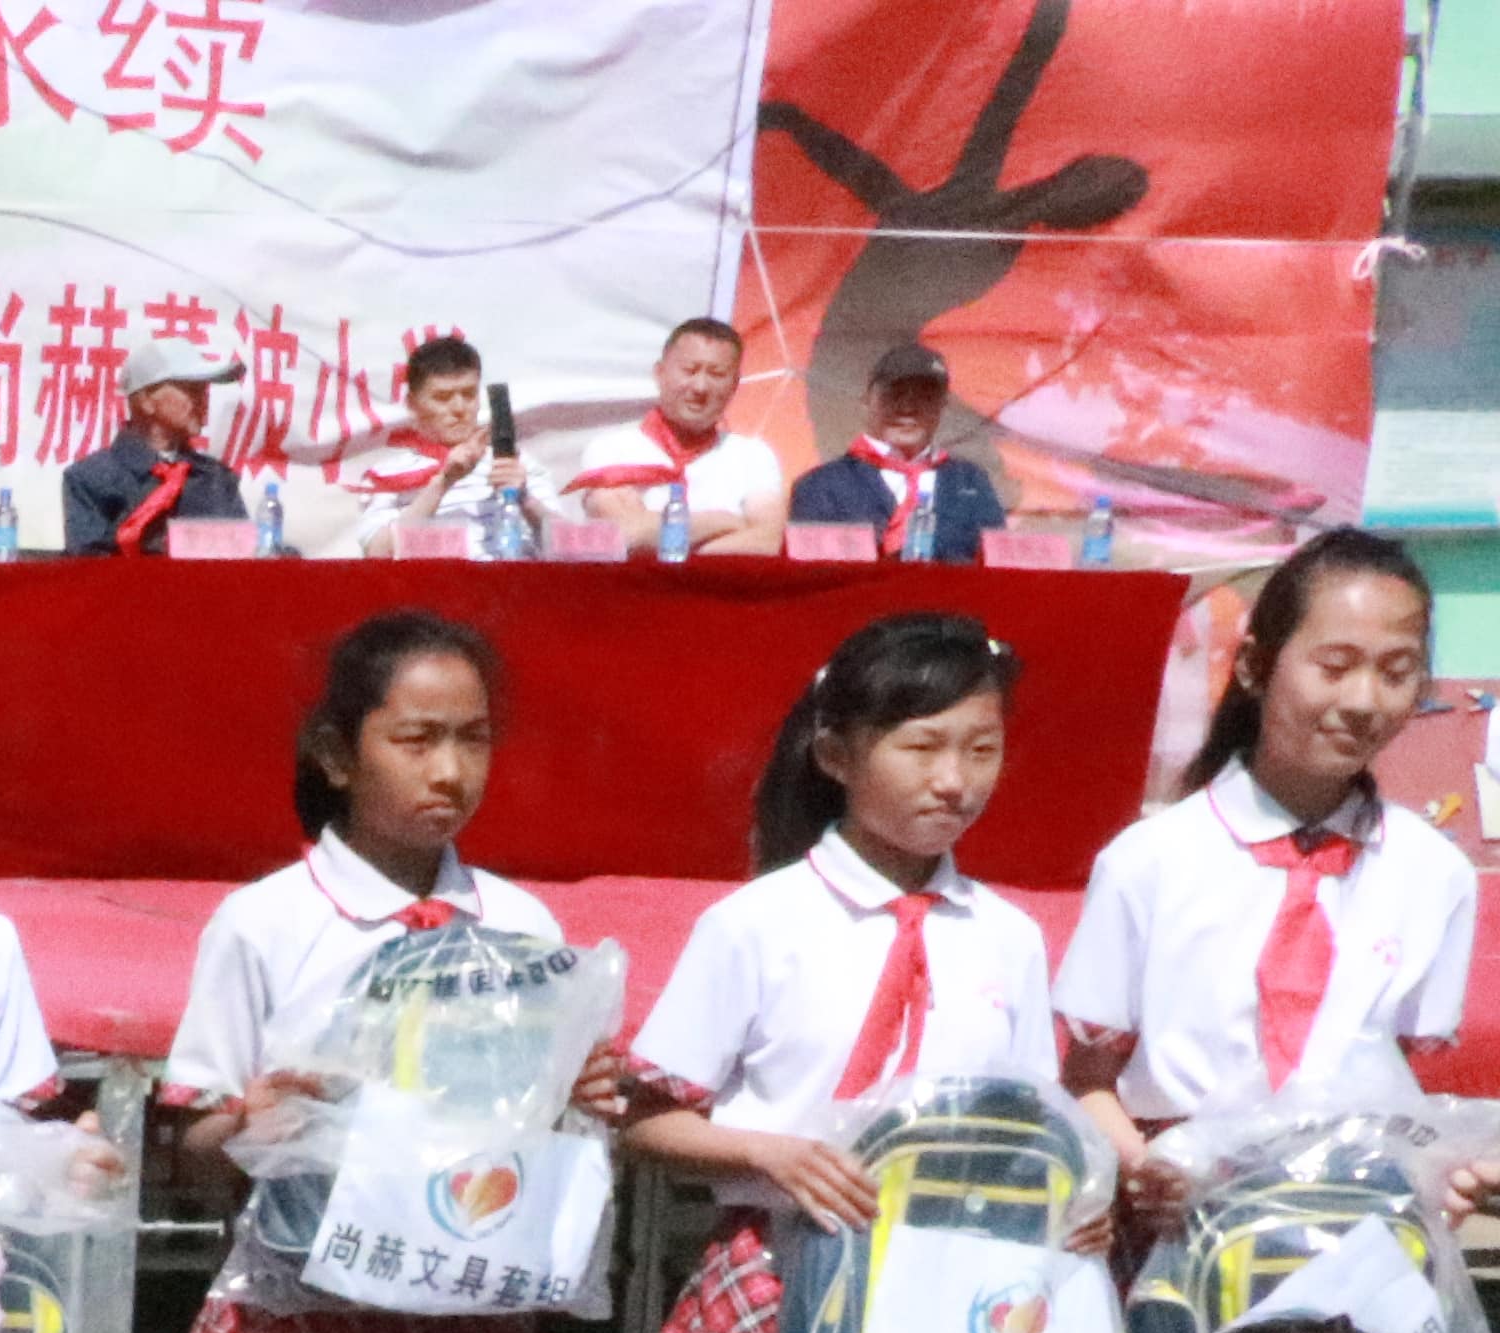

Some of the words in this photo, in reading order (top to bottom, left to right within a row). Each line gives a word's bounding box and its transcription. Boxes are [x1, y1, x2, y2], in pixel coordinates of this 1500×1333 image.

[320, 1222, 570, 1307] 尚赫文具套组
